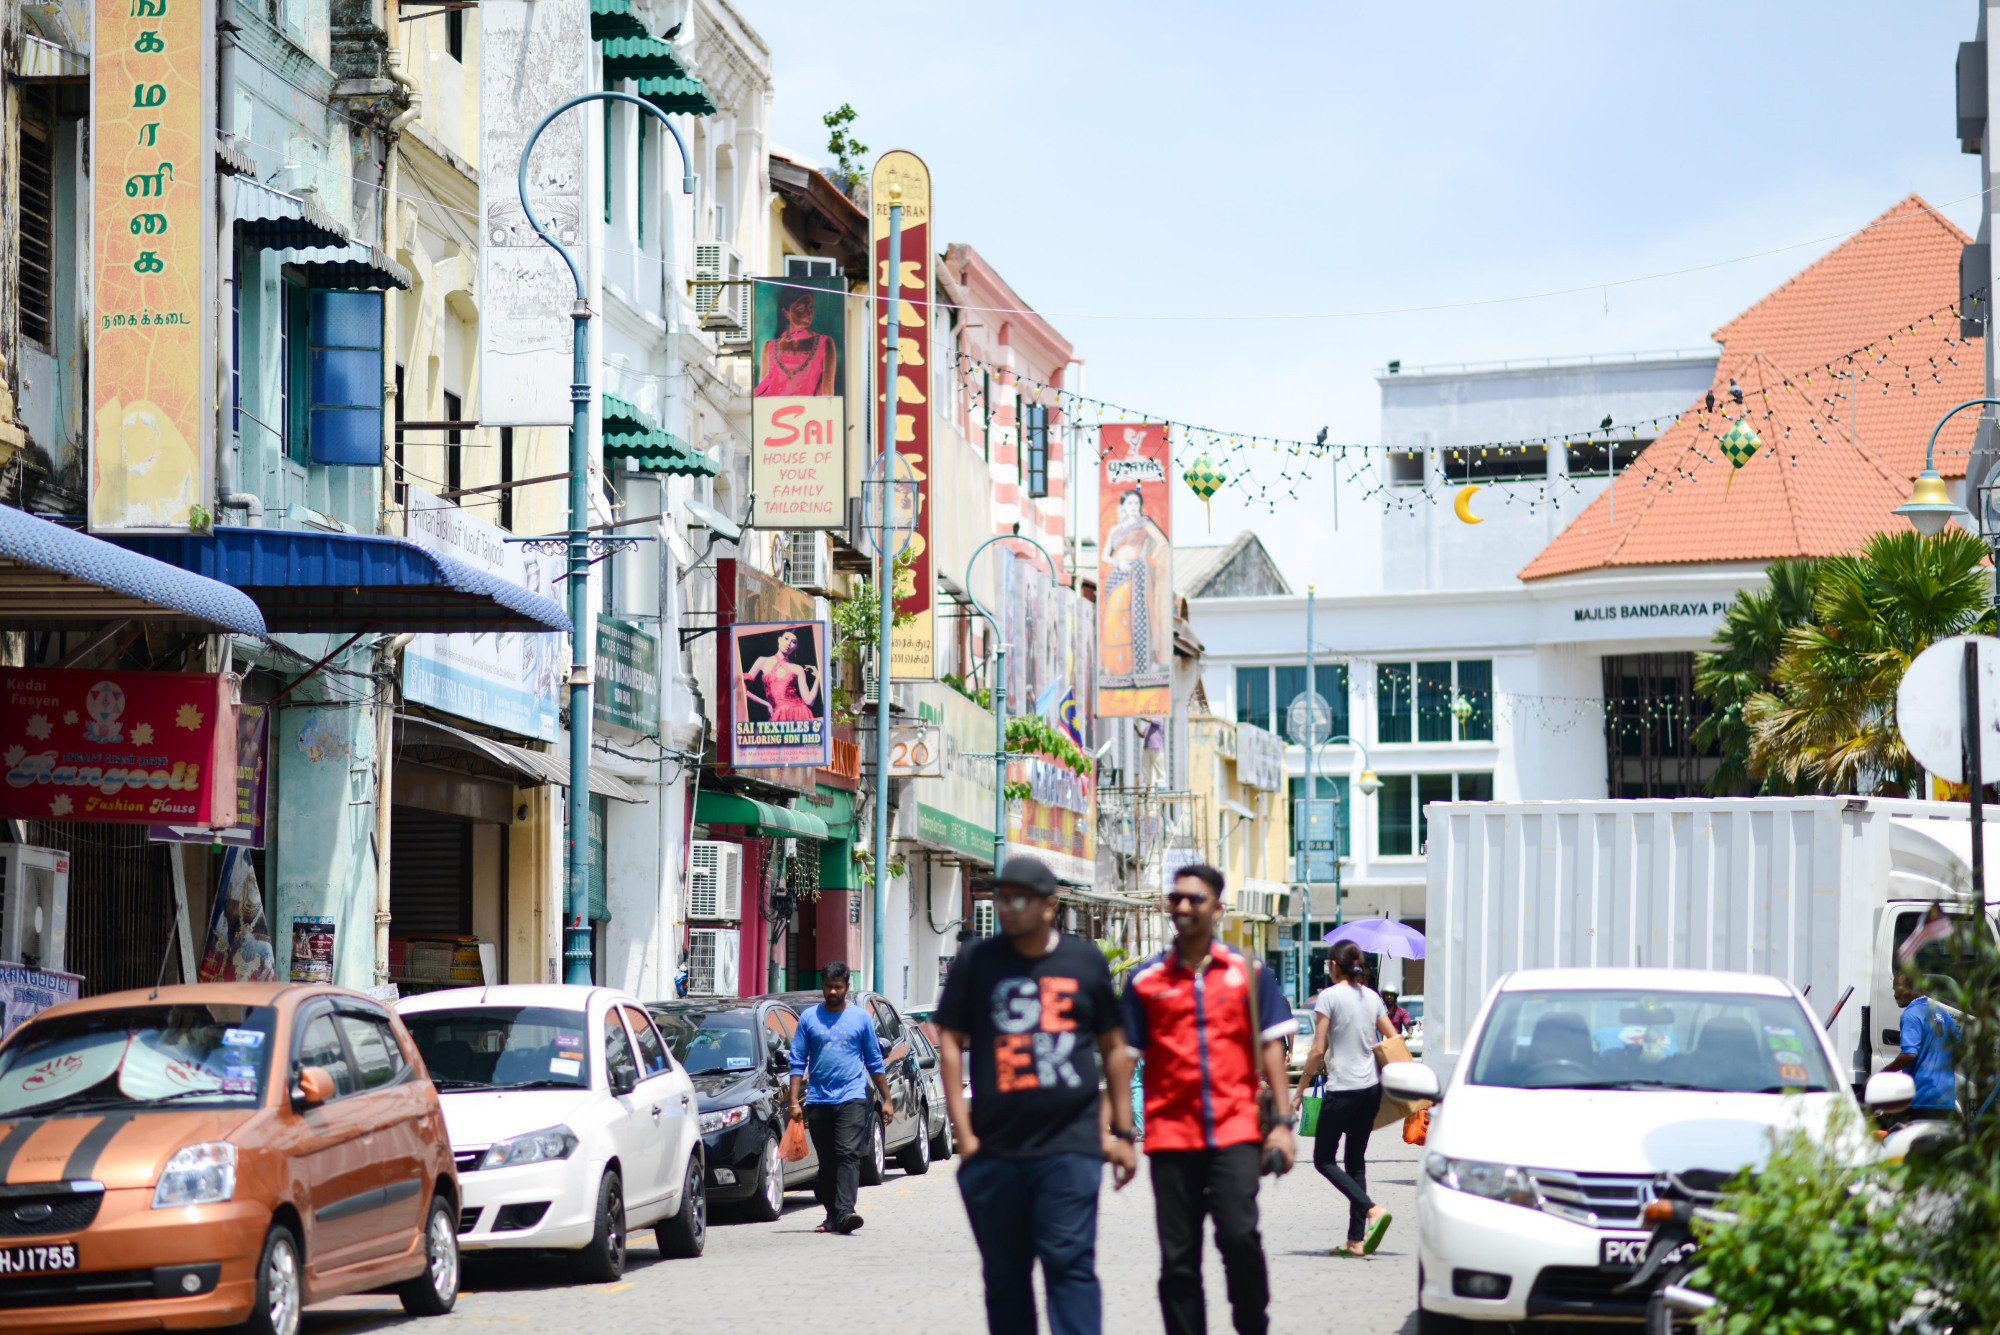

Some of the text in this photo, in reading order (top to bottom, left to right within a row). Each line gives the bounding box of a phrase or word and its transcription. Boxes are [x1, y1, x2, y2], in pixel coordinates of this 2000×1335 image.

[101, 308, 191, 331] நகைக்கடை
[763, 404, 833, 447] SAI
[762, 451, 832, 465] HOUSE OF
[779, 468, 817, 480] YOUR
[773, 484, 824, 498] FAMILY
[764, 501, 833, 514] TAILORING
[1574, 606, 1617, 621] MAJLIS
[1620, 602, 1708, 618] BANDARAYA
[602, 637, 616, 653] SPICES
[609, 661, 614, 681] &
[615, 661, 642, 691] MOHAMED
[7, 677, 47, 692] Kedai
[11, 692, 60, 709] Fesyen
[737, 720, 822, 734] SAI TEXTILES &
[737, 733, 821, 745] TAILORING SDN BHD
[6, 751, 199, 795] Rangooli
[85, 796, 196, 814] Fashion House
[0, 965, 71, 993] RANGOOLI
